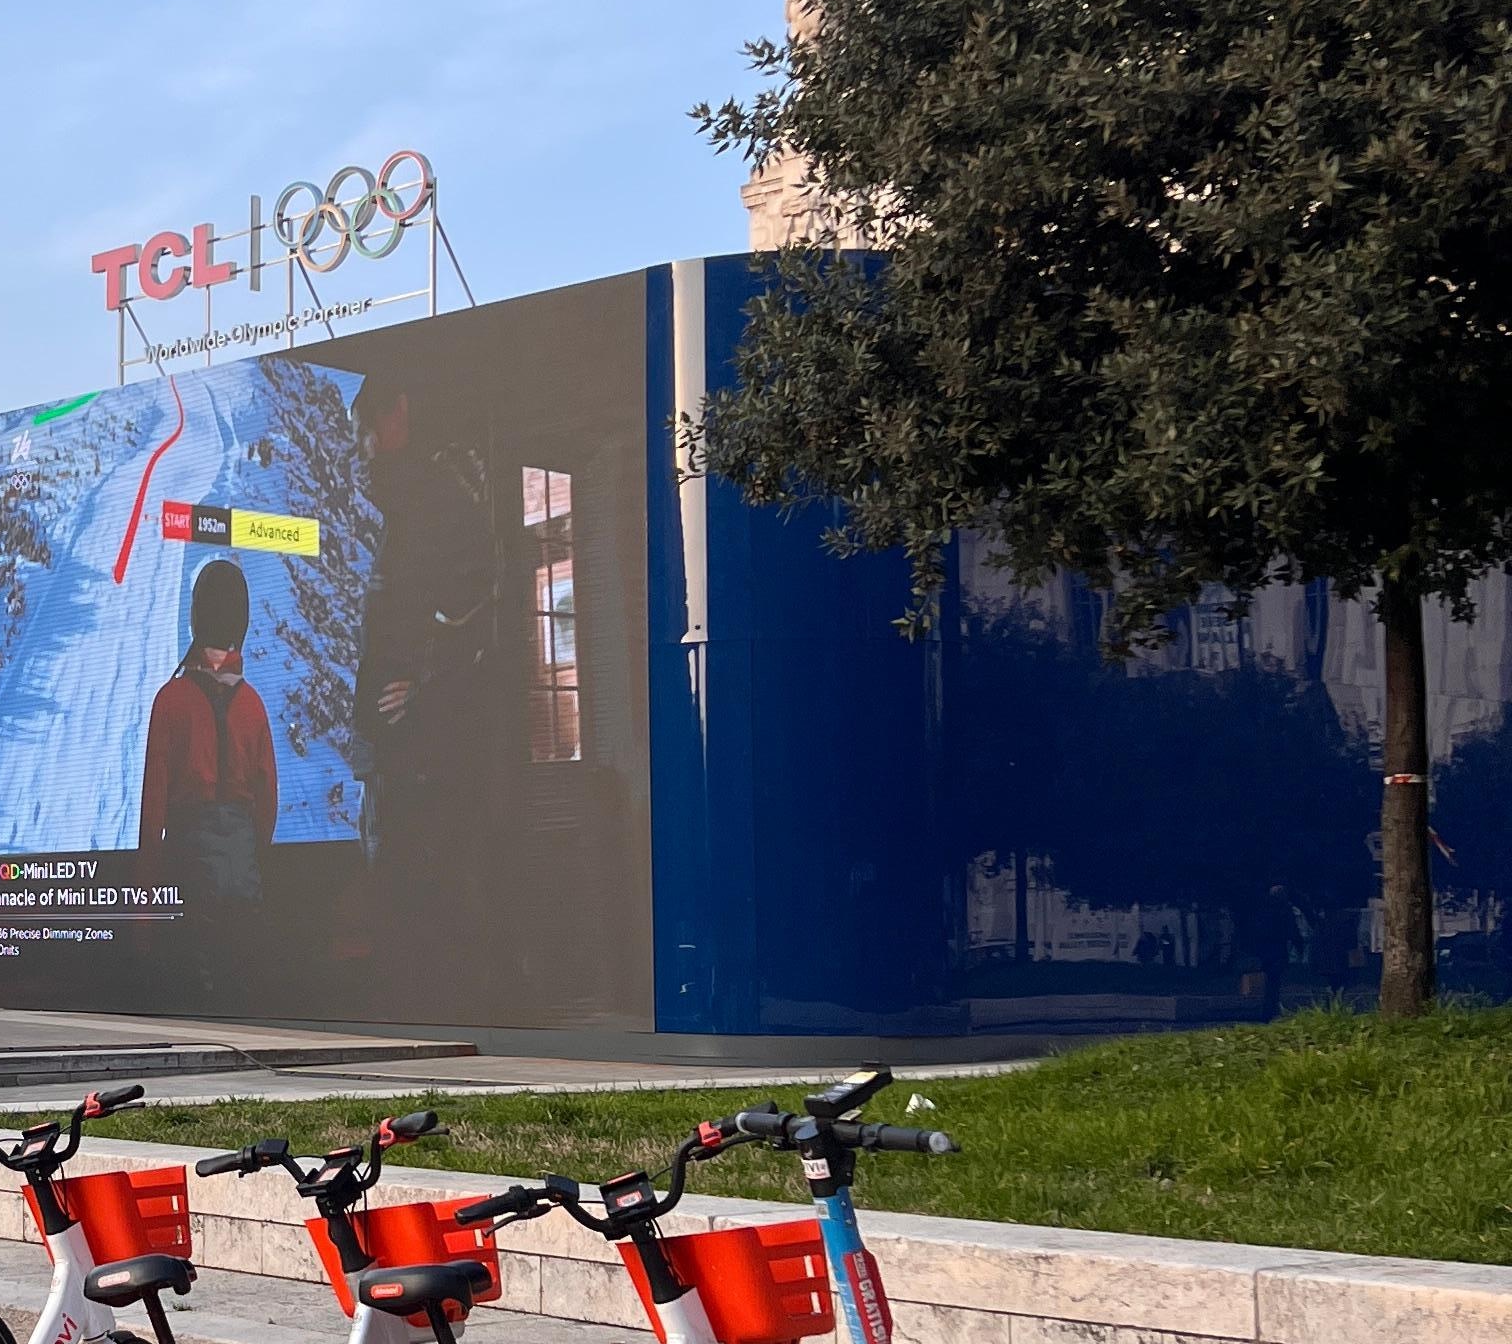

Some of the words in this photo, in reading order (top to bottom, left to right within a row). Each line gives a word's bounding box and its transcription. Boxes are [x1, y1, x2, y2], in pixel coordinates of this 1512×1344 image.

[91, 223, 237, 311] TCL
[144, 330, 227, 363] Worldwide
[230, 314, 299, 347] Olympic
[302, 297, 373, 328] Partner
[164, 512, 190, 528] START
[198, 516, 227, 533] 1952m
[249, 522, 300, 542] Advanced
[78, 861, 98, 879] TV
[39, 888, 54, 906] of
[57, 888, 85, 906] Mini
[89, 888, 118, 905] LED
[121, 887, 148, 905] TVs
[152, 887, 184, 905] X11L
[10, 928, 40, 940] Precise
[42, 928, 83, 942] Dimming
[85, 928, 113, 940] Zones
